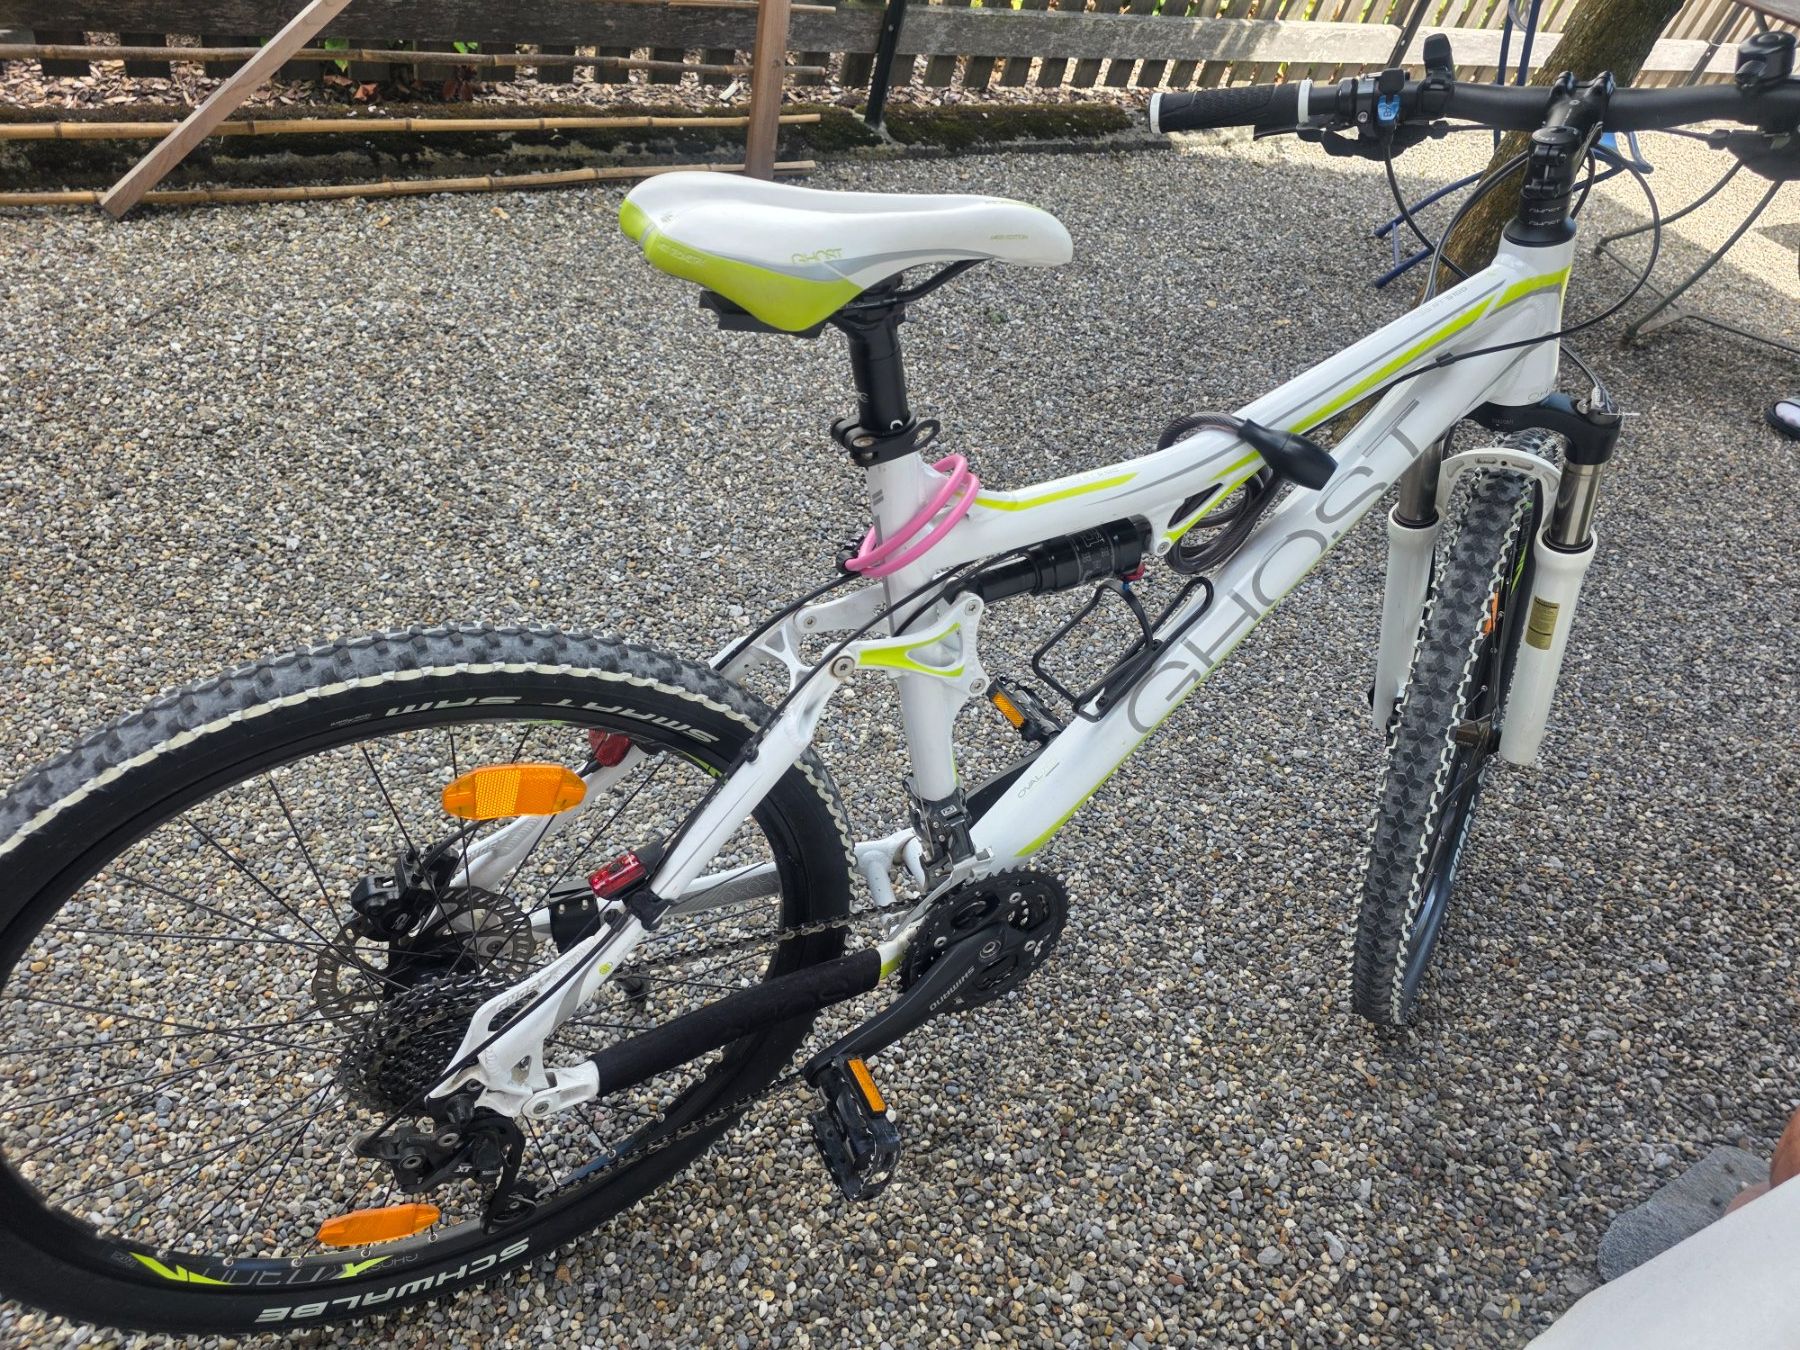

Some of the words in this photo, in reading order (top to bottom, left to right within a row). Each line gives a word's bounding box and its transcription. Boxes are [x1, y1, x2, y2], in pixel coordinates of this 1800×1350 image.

[791, 248, 842, 264] GHOST
[1127, 400, 1420, 733] GHOST
[385, 696, 522, 717] SAM
[545, 698, 720, 743] SMART
[930, 966, 975, 1011] SHIMANO
[254, 1237, 530, 1323] SCHWALBE
